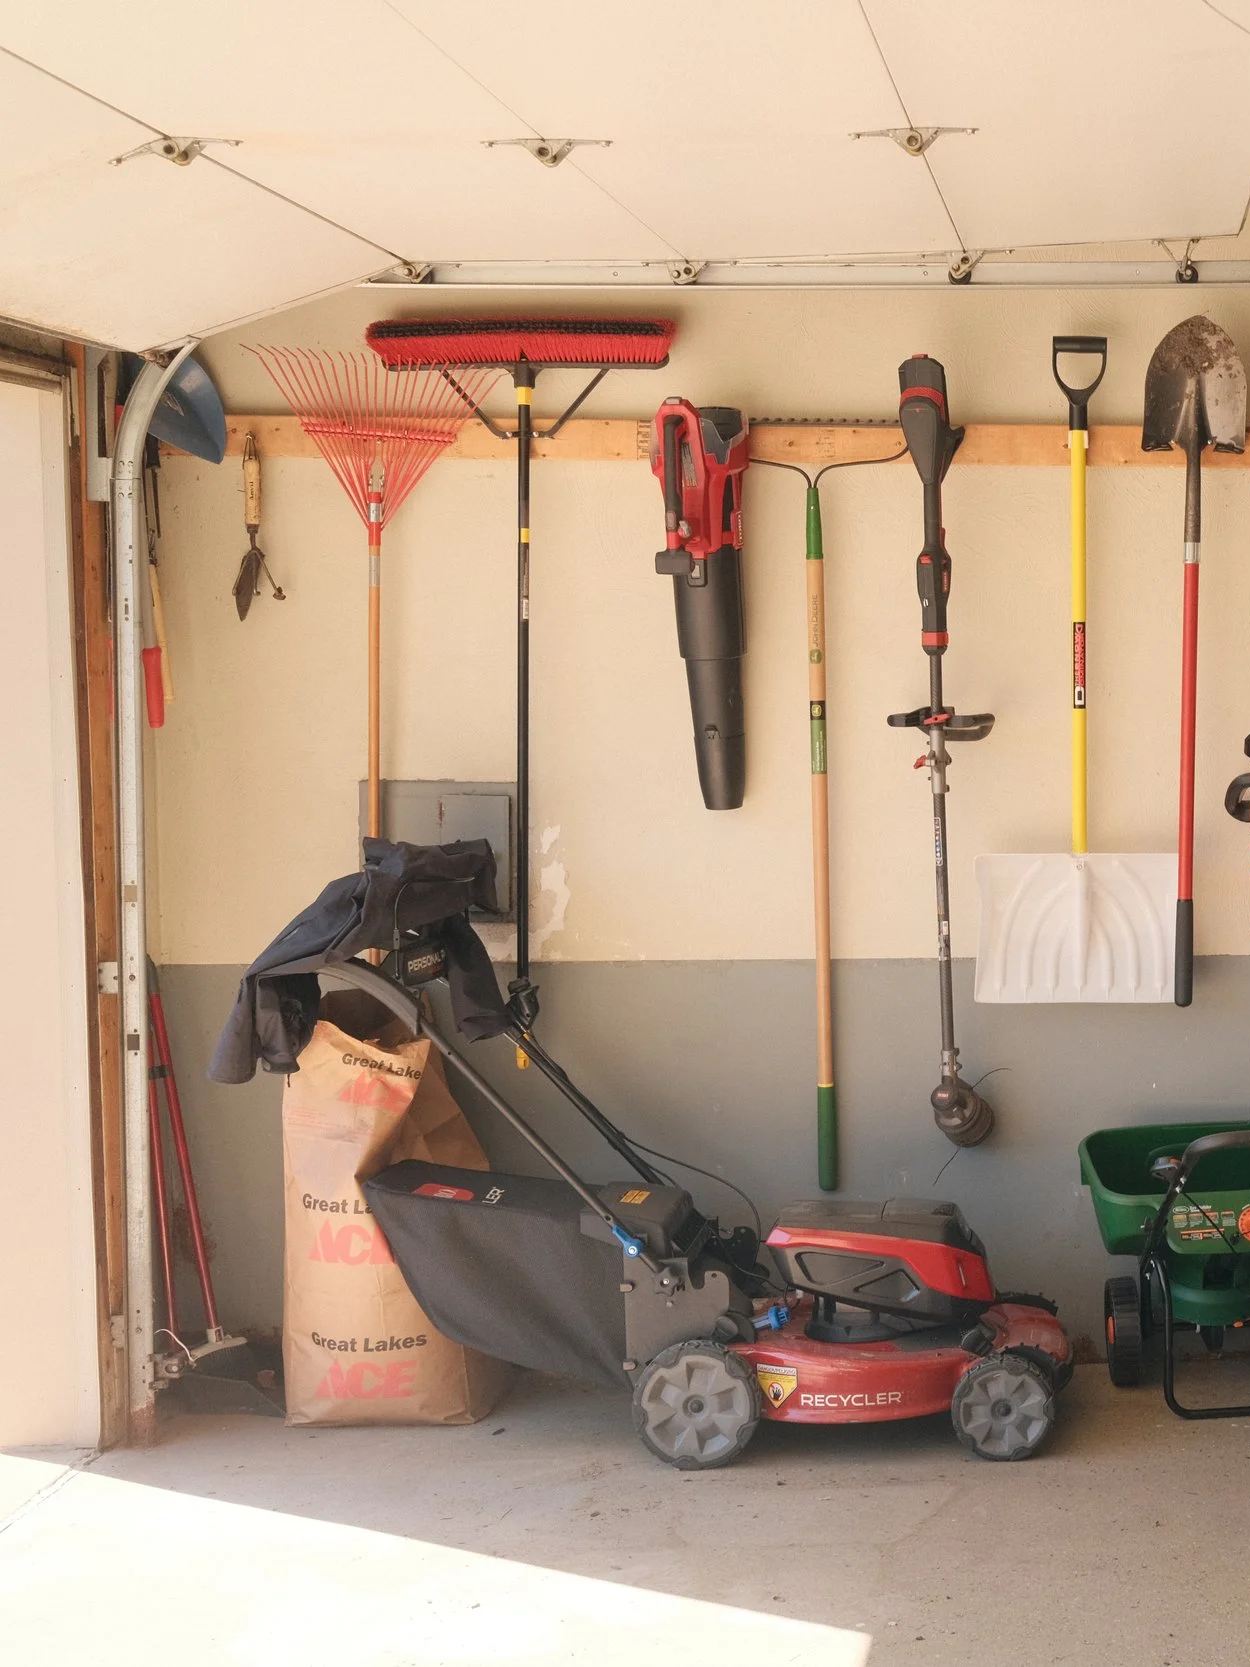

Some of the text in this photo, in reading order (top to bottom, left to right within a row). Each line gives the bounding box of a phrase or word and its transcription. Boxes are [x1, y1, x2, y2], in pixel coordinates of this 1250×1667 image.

[811, 594, 819, 648] JOHN DEERE
[407, 952, 442, 973] PERSONAL
[342, 1053, 384, 1070] Great
[302, 1193, 348, 1214] Great
[311, 1331, 428, 1353] Great Lakes
[314, 1356, 418, 1399] ACE
[800, 1391, 902, 1408] RECYCLER
